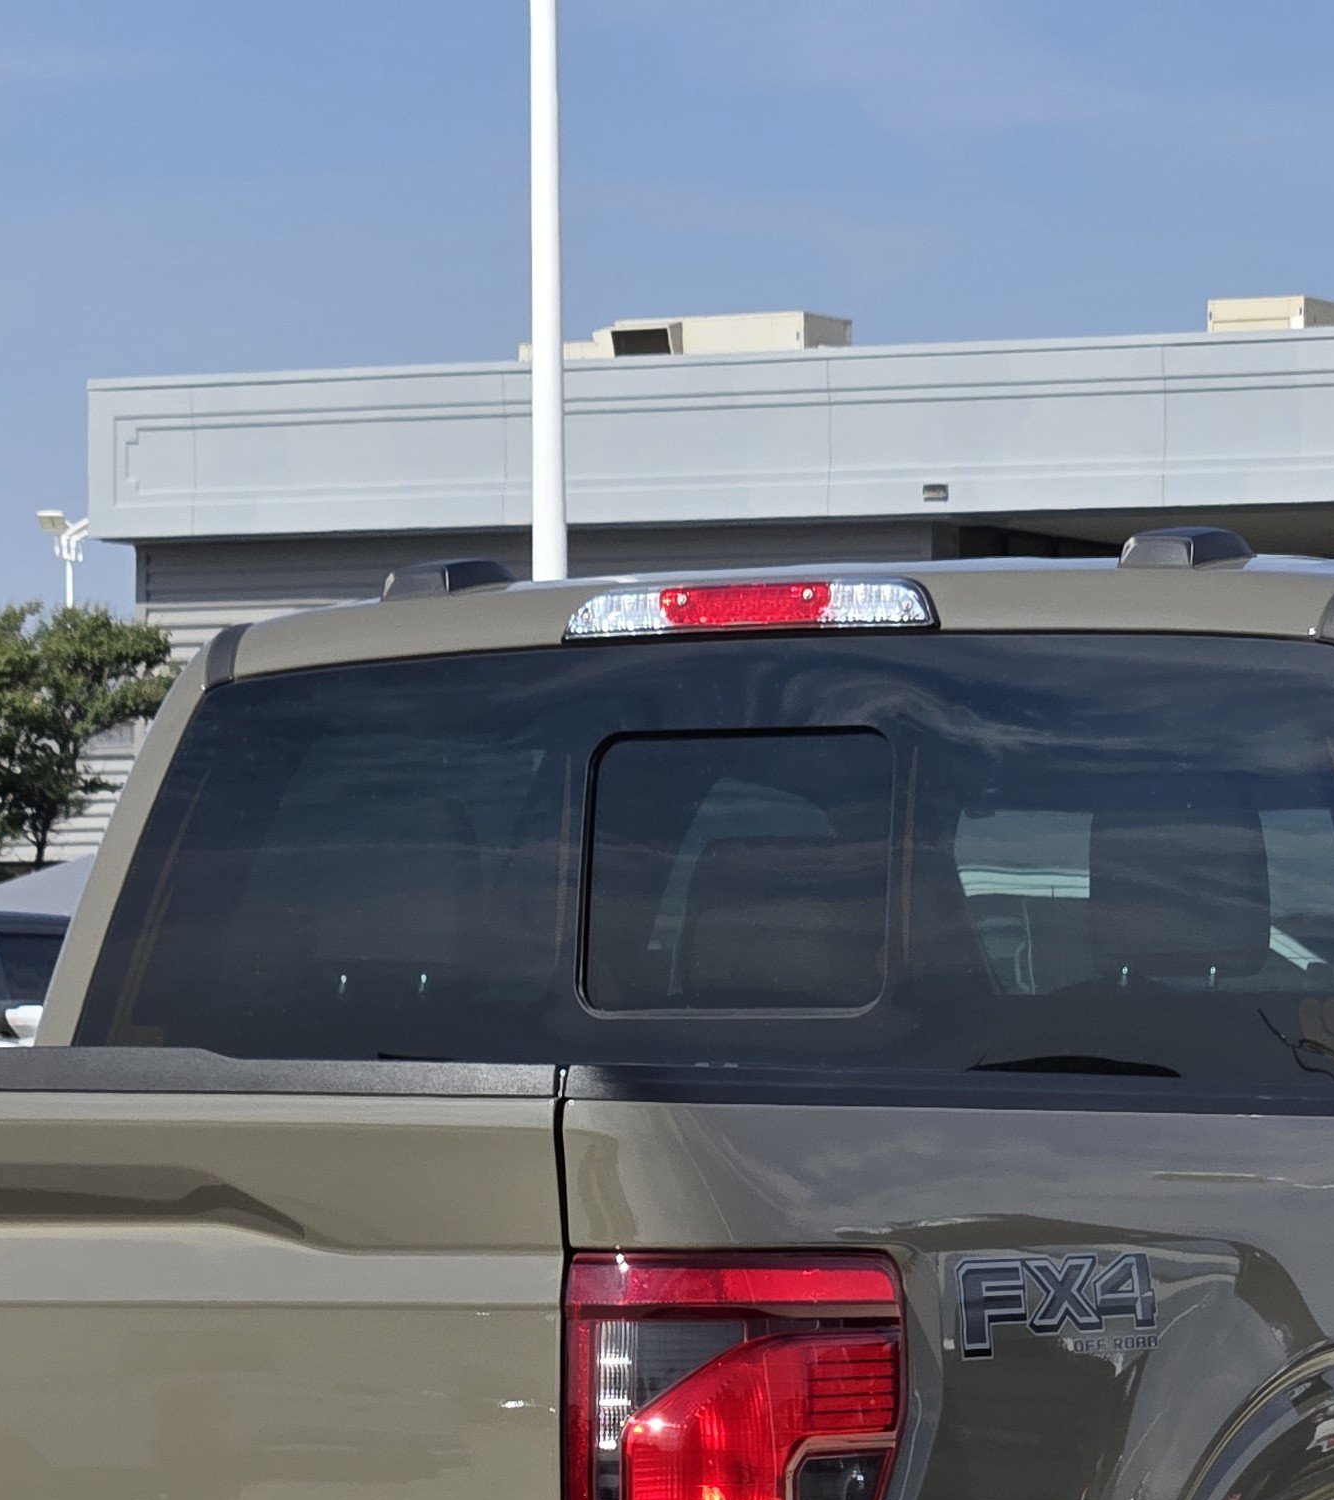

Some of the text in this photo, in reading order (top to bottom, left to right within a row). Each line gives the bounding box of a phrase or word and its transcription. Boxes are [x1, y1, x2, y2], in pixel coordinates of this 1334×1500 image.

[955, 1253, 1158, 1361] FX4
[1074, 1335, 1159, 1353] OFF ROAD
